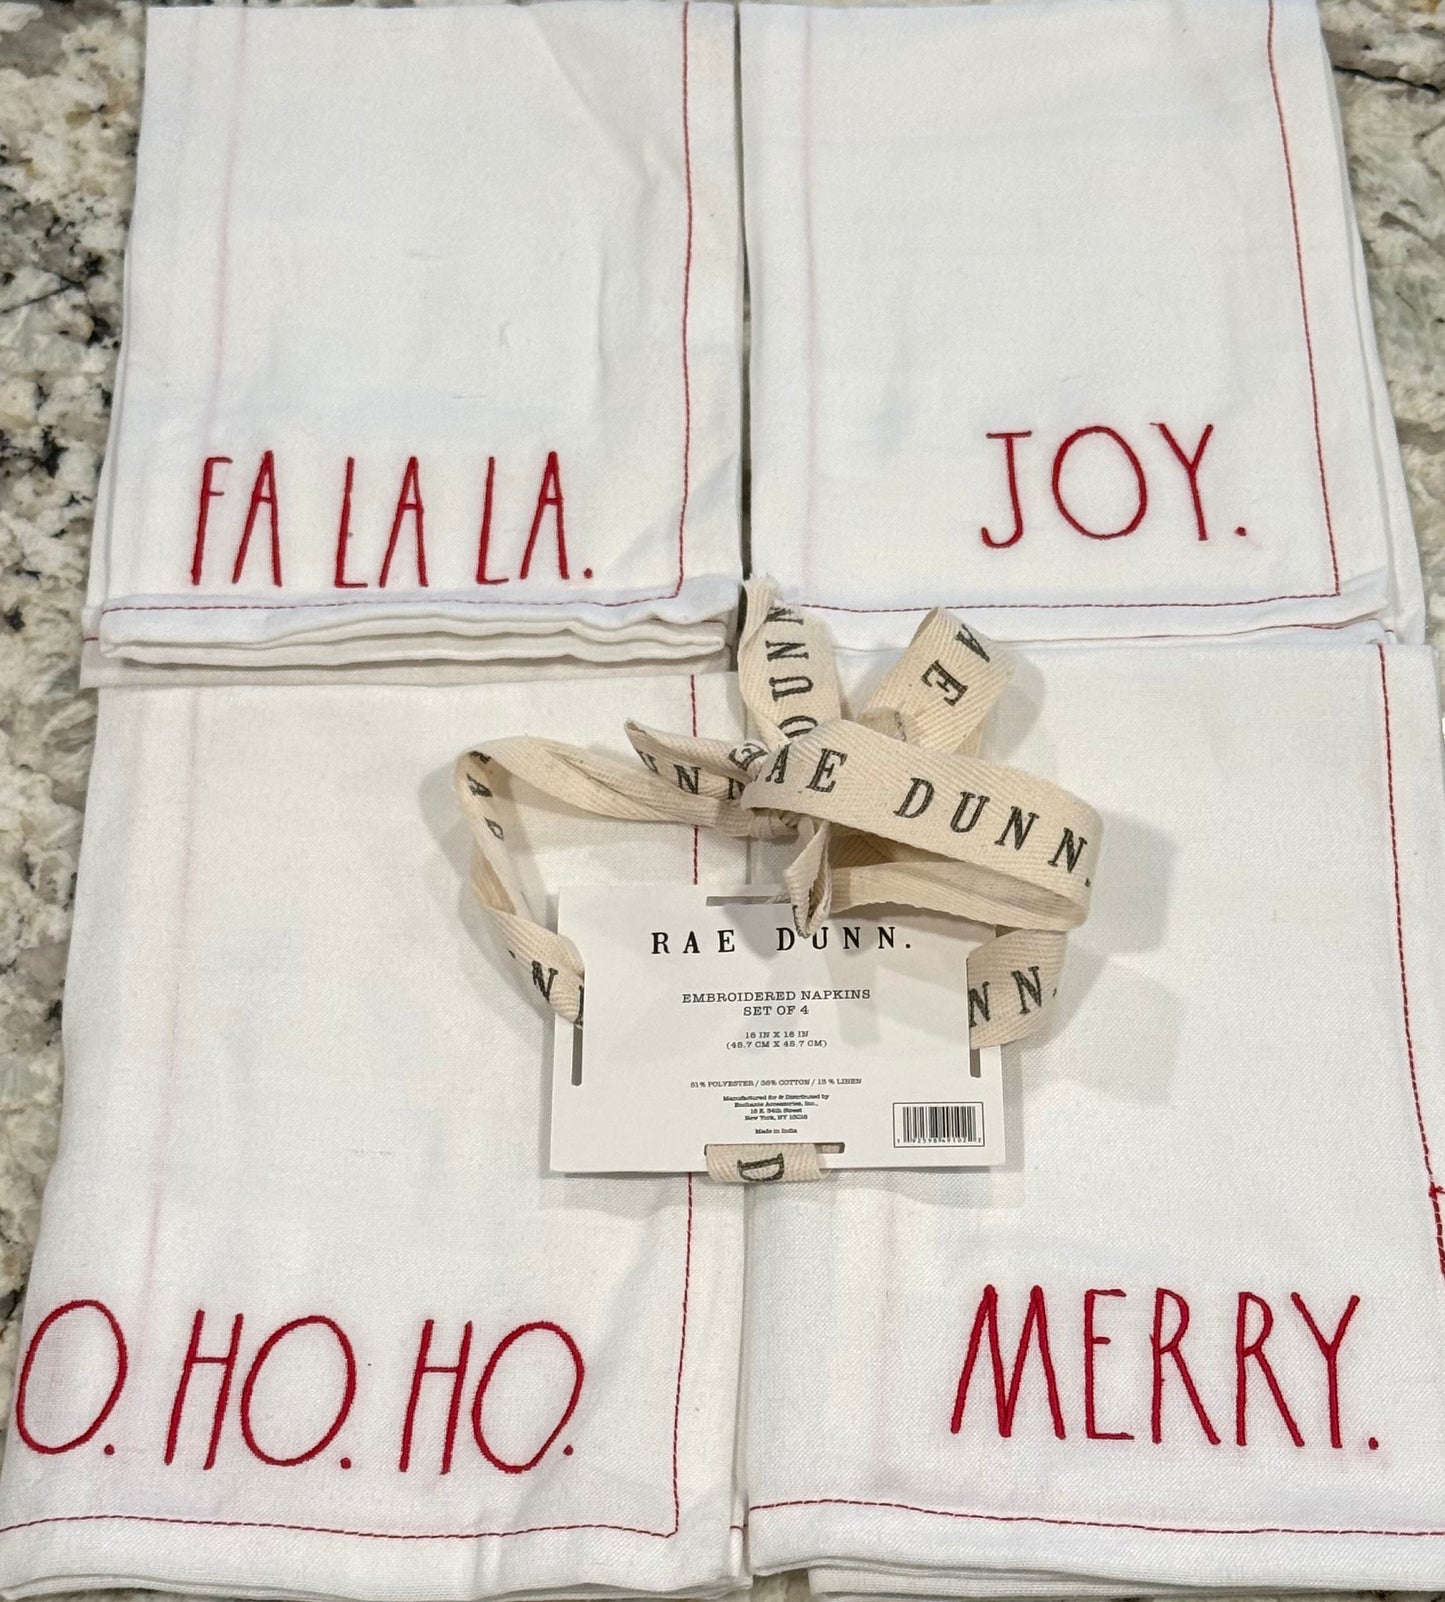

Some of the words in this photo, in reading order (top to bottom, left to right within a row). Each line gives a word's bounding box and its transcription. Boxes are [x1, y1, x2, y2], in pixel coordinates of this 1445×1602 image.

[190, 450, 283, 587] FA
[334, 455, 429, 588] LA
[476, 450, 593, 585] LA.
[980, 422, 1247, 549] JOY.
[892, 777, 1092, 888] DUNN.
[650, 930, 735, 954] RAE
[776, 926, 912, 951] DUNN.
[682, 990, 796, 1004] EMBROIDERED
[800, 989, 871, 1000] NAPKINS
[743, 1006, 772, 1016] SET
[776, 1006, 796, 1016] OF
[800, 1004, 810, 1015] 4
[163, 1308, 357, 1471] HO.
[399, 1316, 586, 1477] HO.
[950, 1284, 1379, 1451] MERRY.
